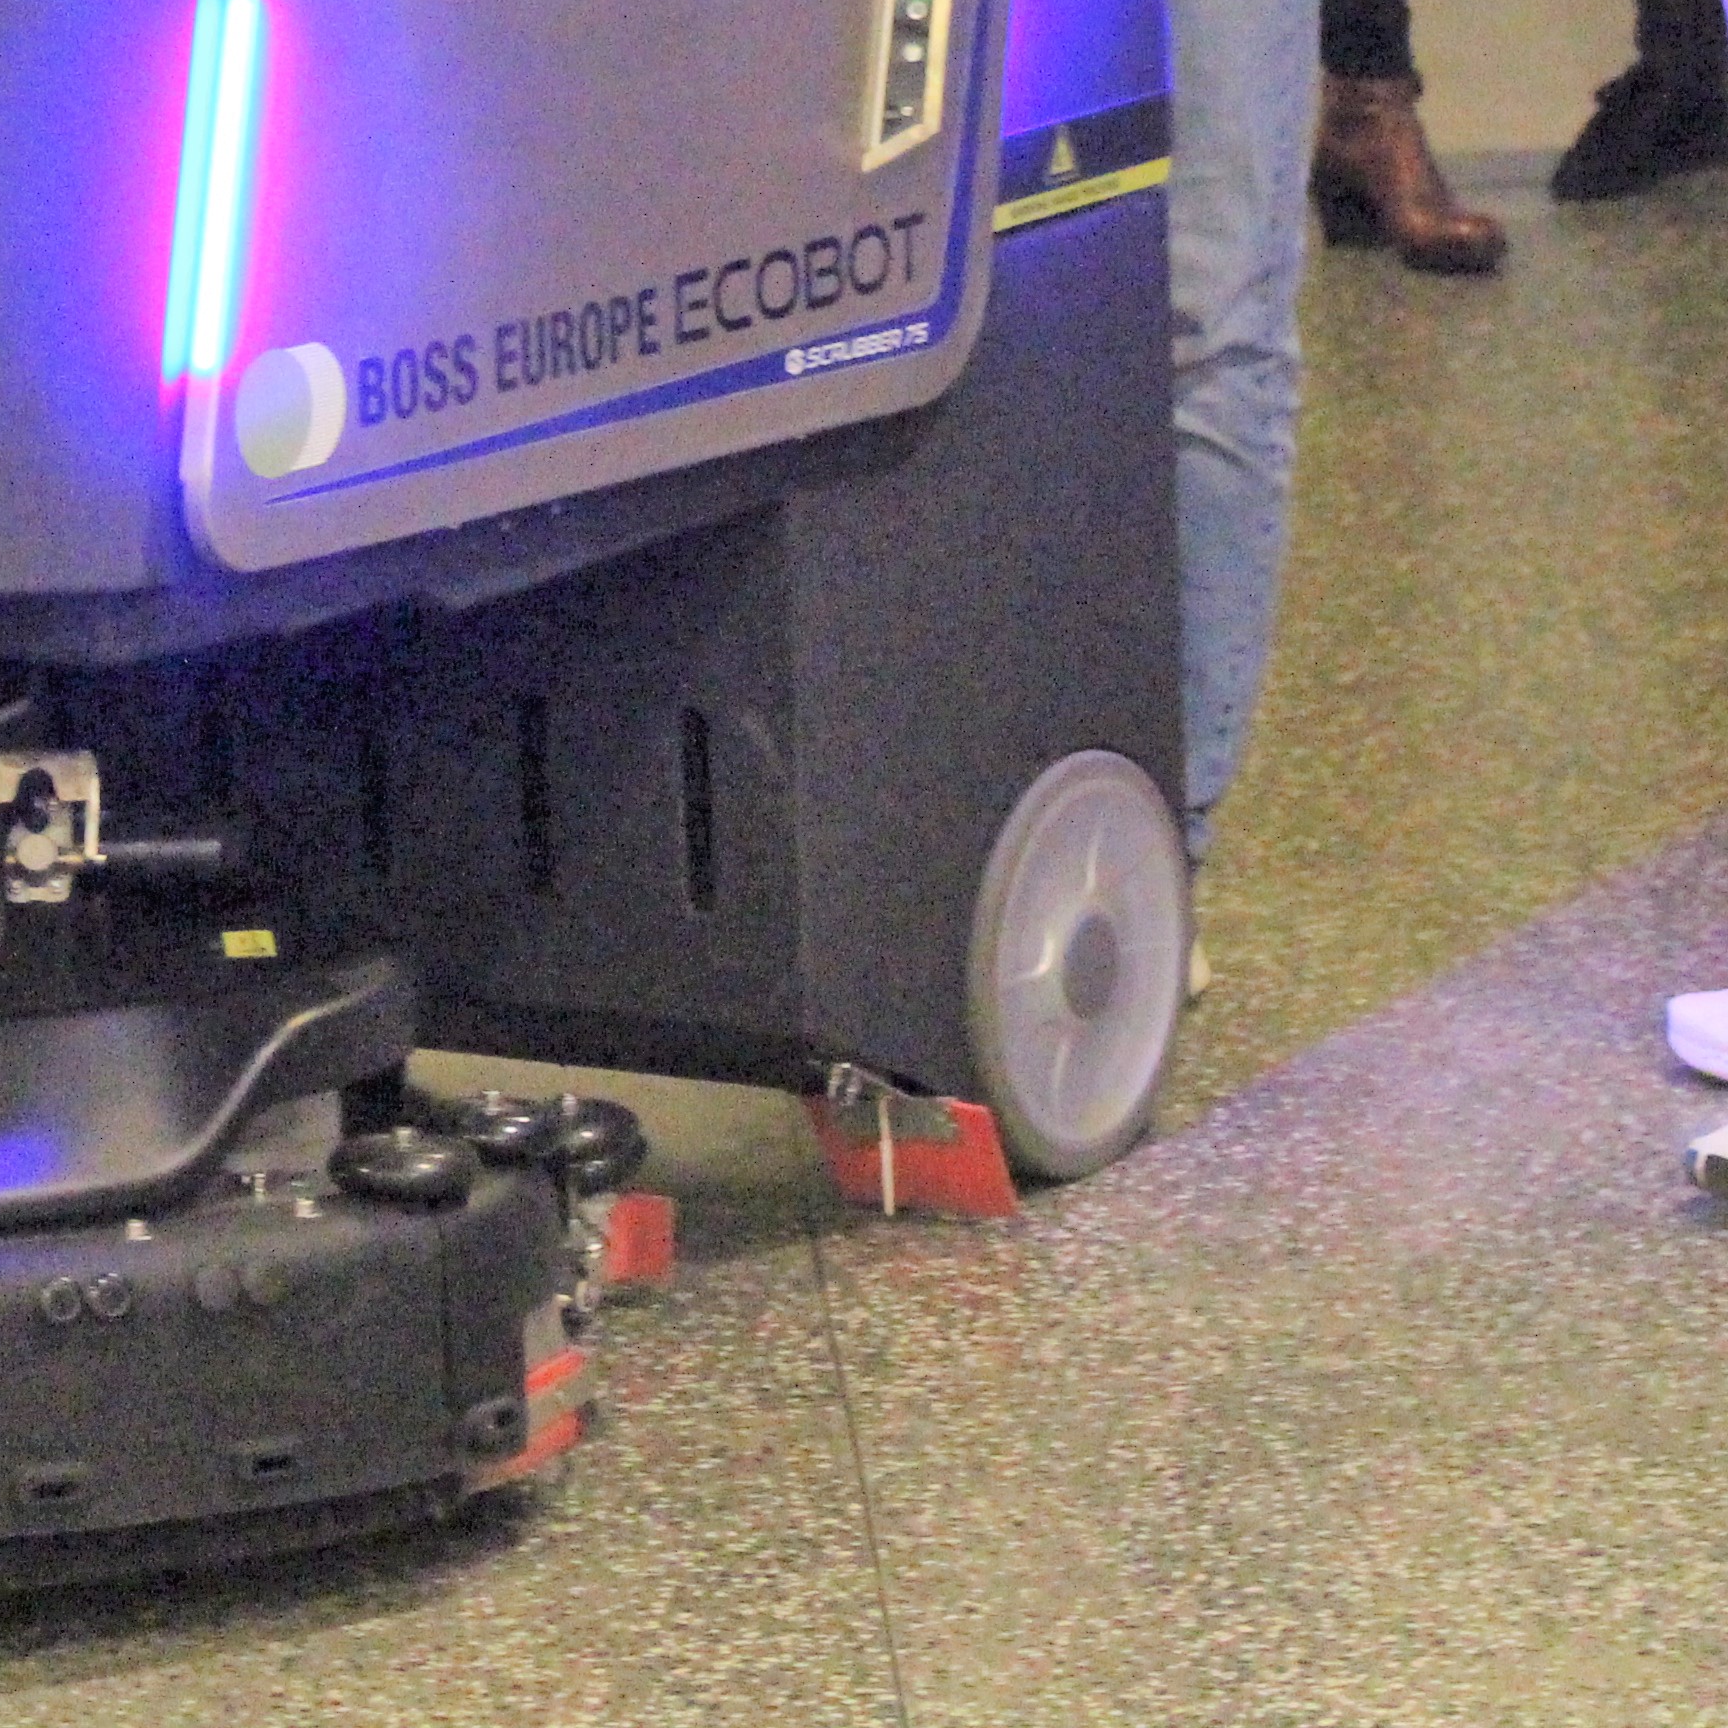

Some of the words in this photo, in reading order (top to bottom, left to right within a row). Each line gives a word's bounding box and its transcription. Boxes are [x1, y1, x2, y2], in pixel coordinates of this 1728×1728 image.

[357, 333, 479, 428] BOSS
[494, 287, 661, 393] EUROPE
[675, 213, 927, 345] ECOBOT
